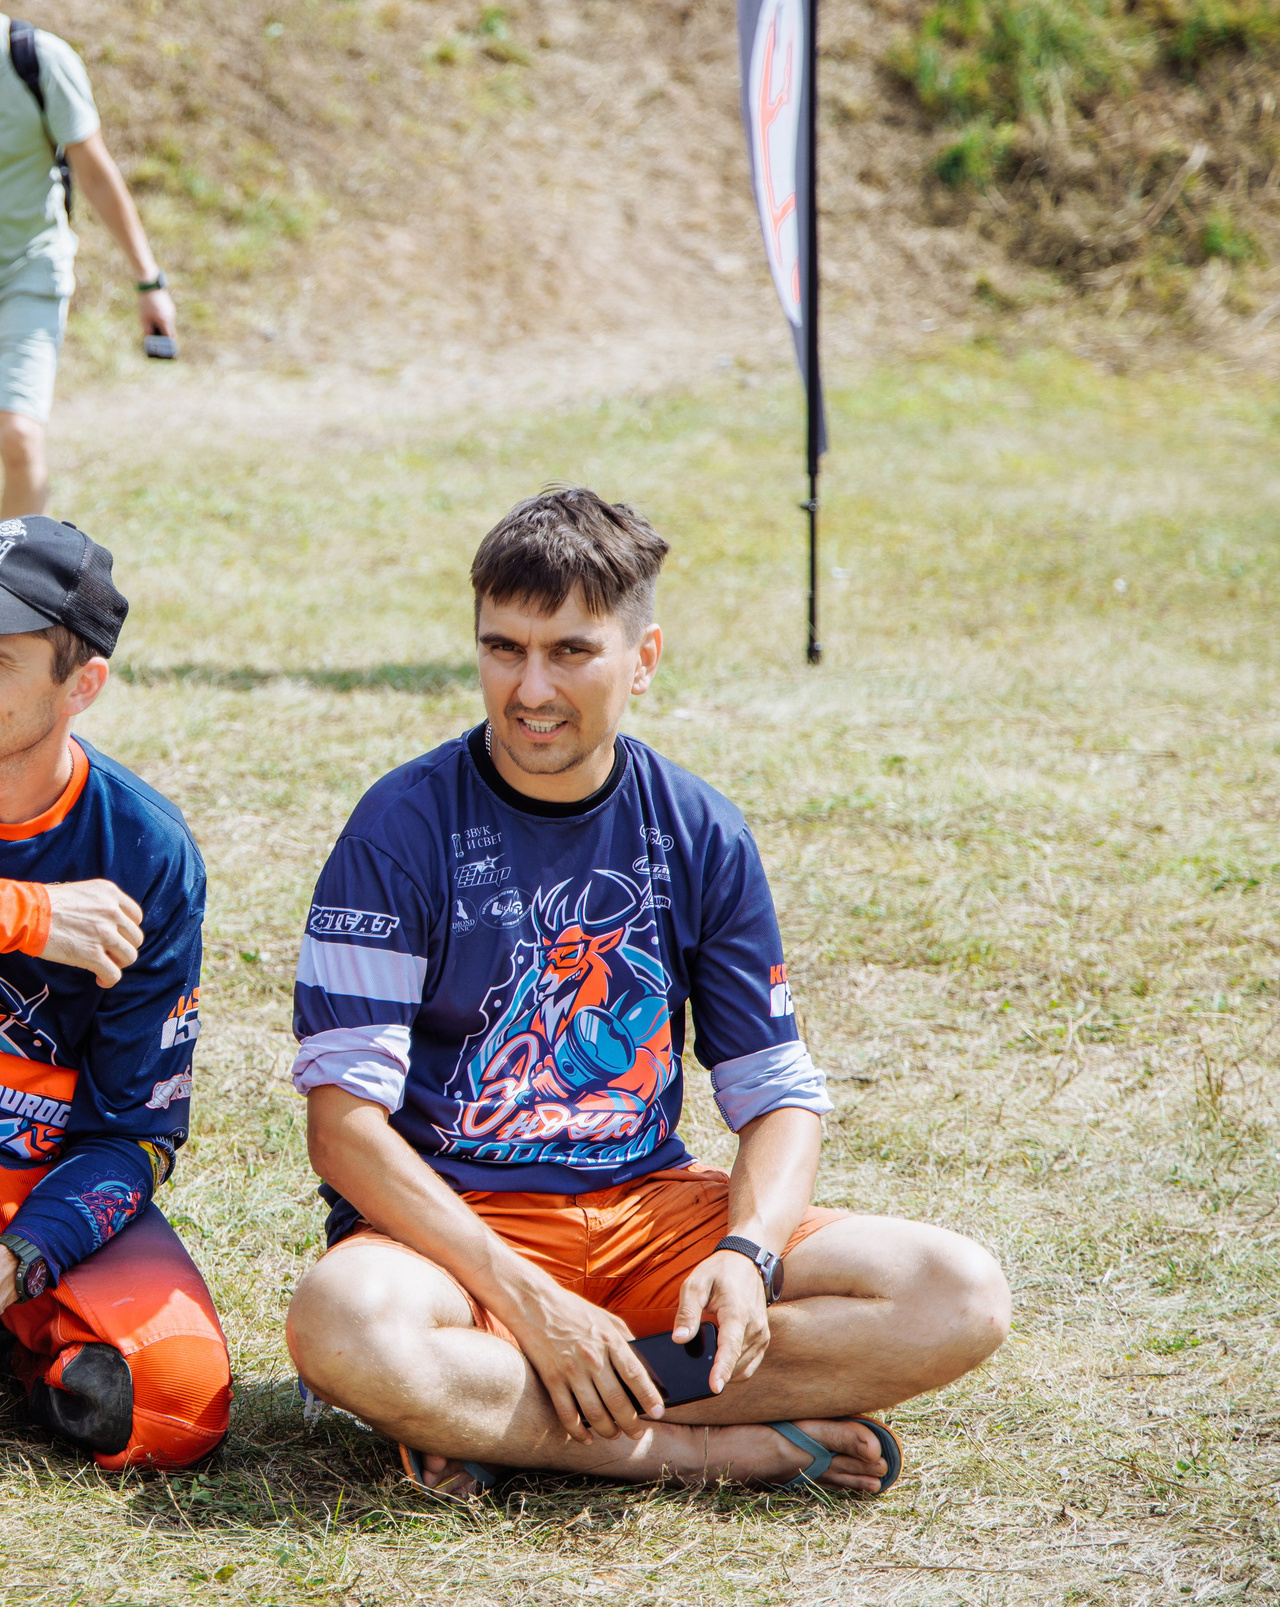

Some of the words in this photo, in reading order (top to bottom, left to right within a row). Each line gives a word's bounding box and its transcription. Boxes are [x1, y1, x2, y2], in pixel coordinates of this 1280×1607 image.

[463, 825, 491, 839] ЗВУК
[466, 839, 476, 850] И
[477, 832, 503, 848] СВЕТ
